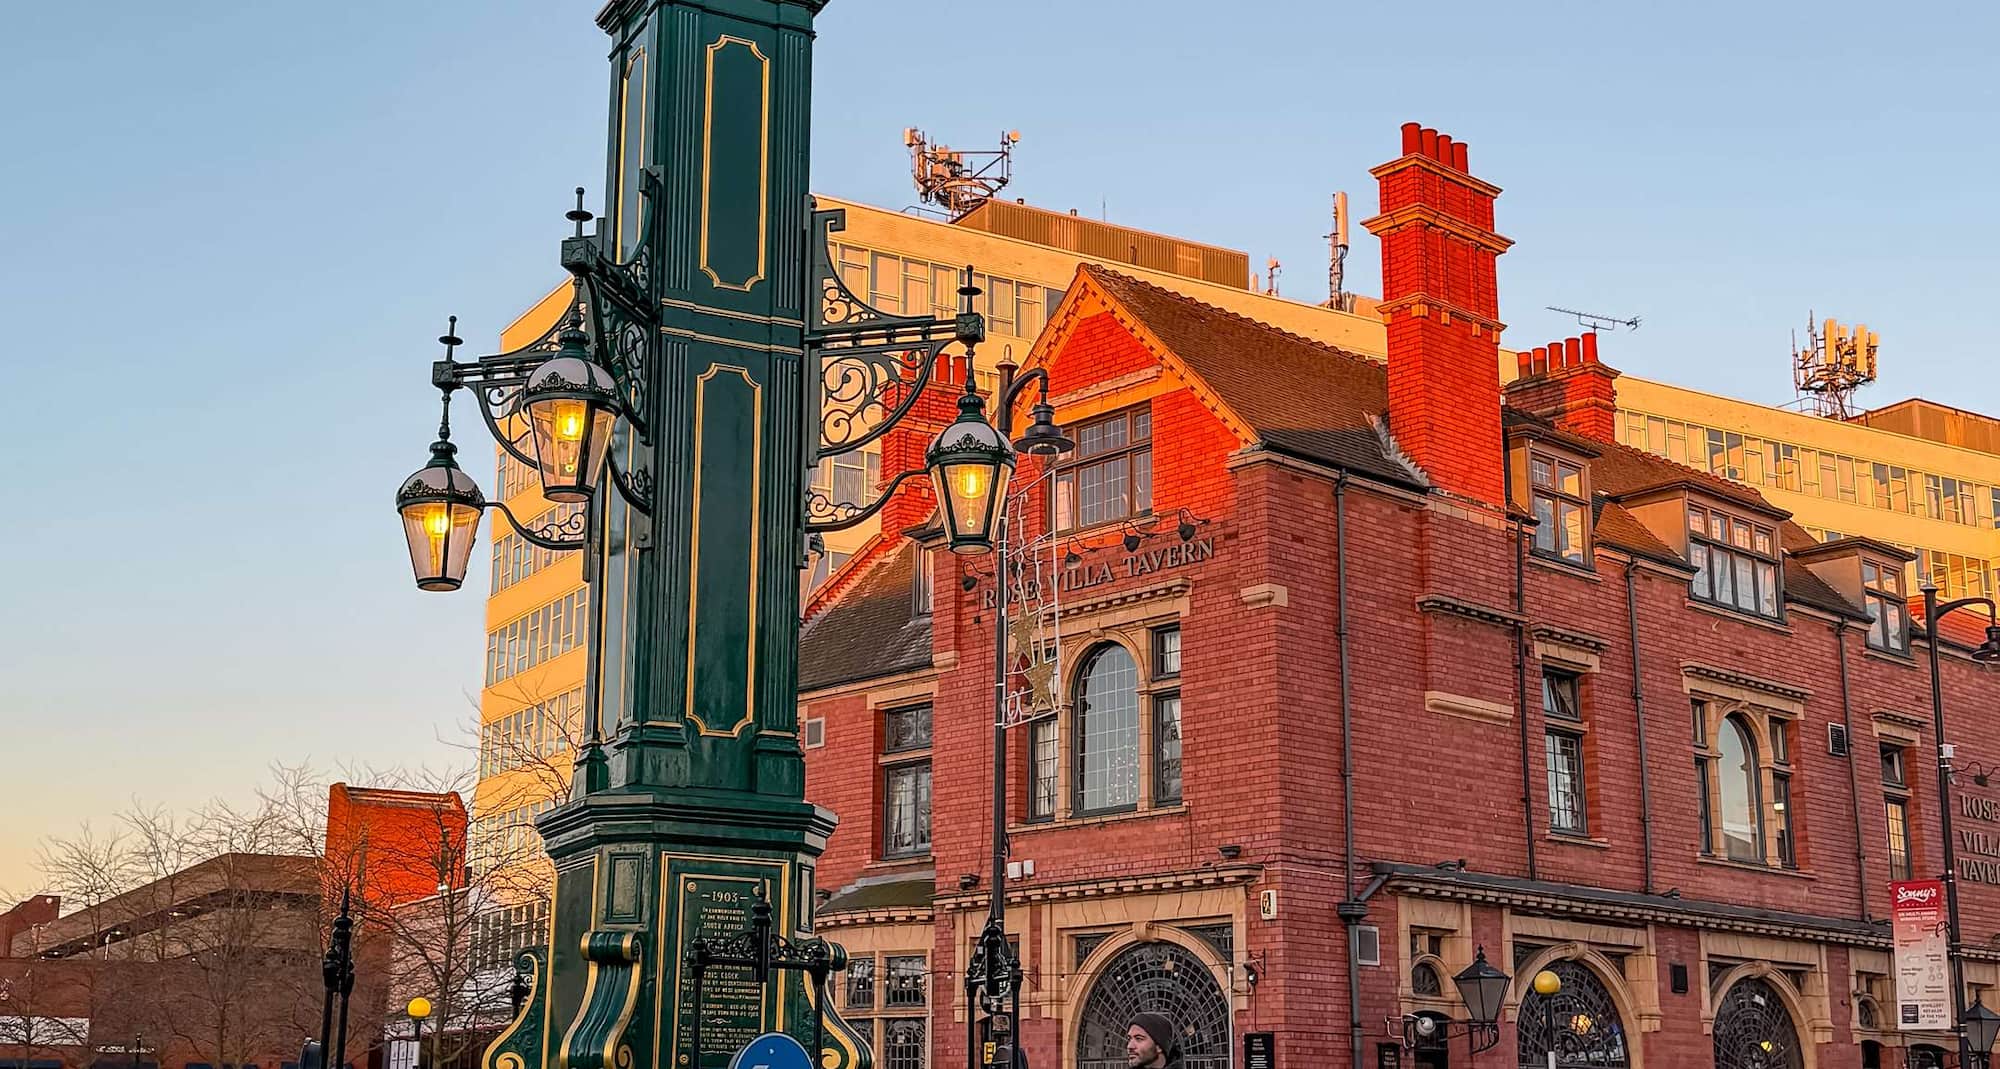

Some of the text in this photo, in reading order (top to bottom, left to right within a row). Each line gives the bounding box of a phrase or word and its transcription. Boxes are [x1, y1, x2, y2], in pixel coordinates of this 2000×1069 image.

[1048, 562, 1115, 592] VILLA
[1122, 537, 1215, 577] TAVERN
[1959, 830, 2000, 858] VILL
[712, 891, 738, 903] 1903
[1897, 886, 1937, 903] Sonny's
